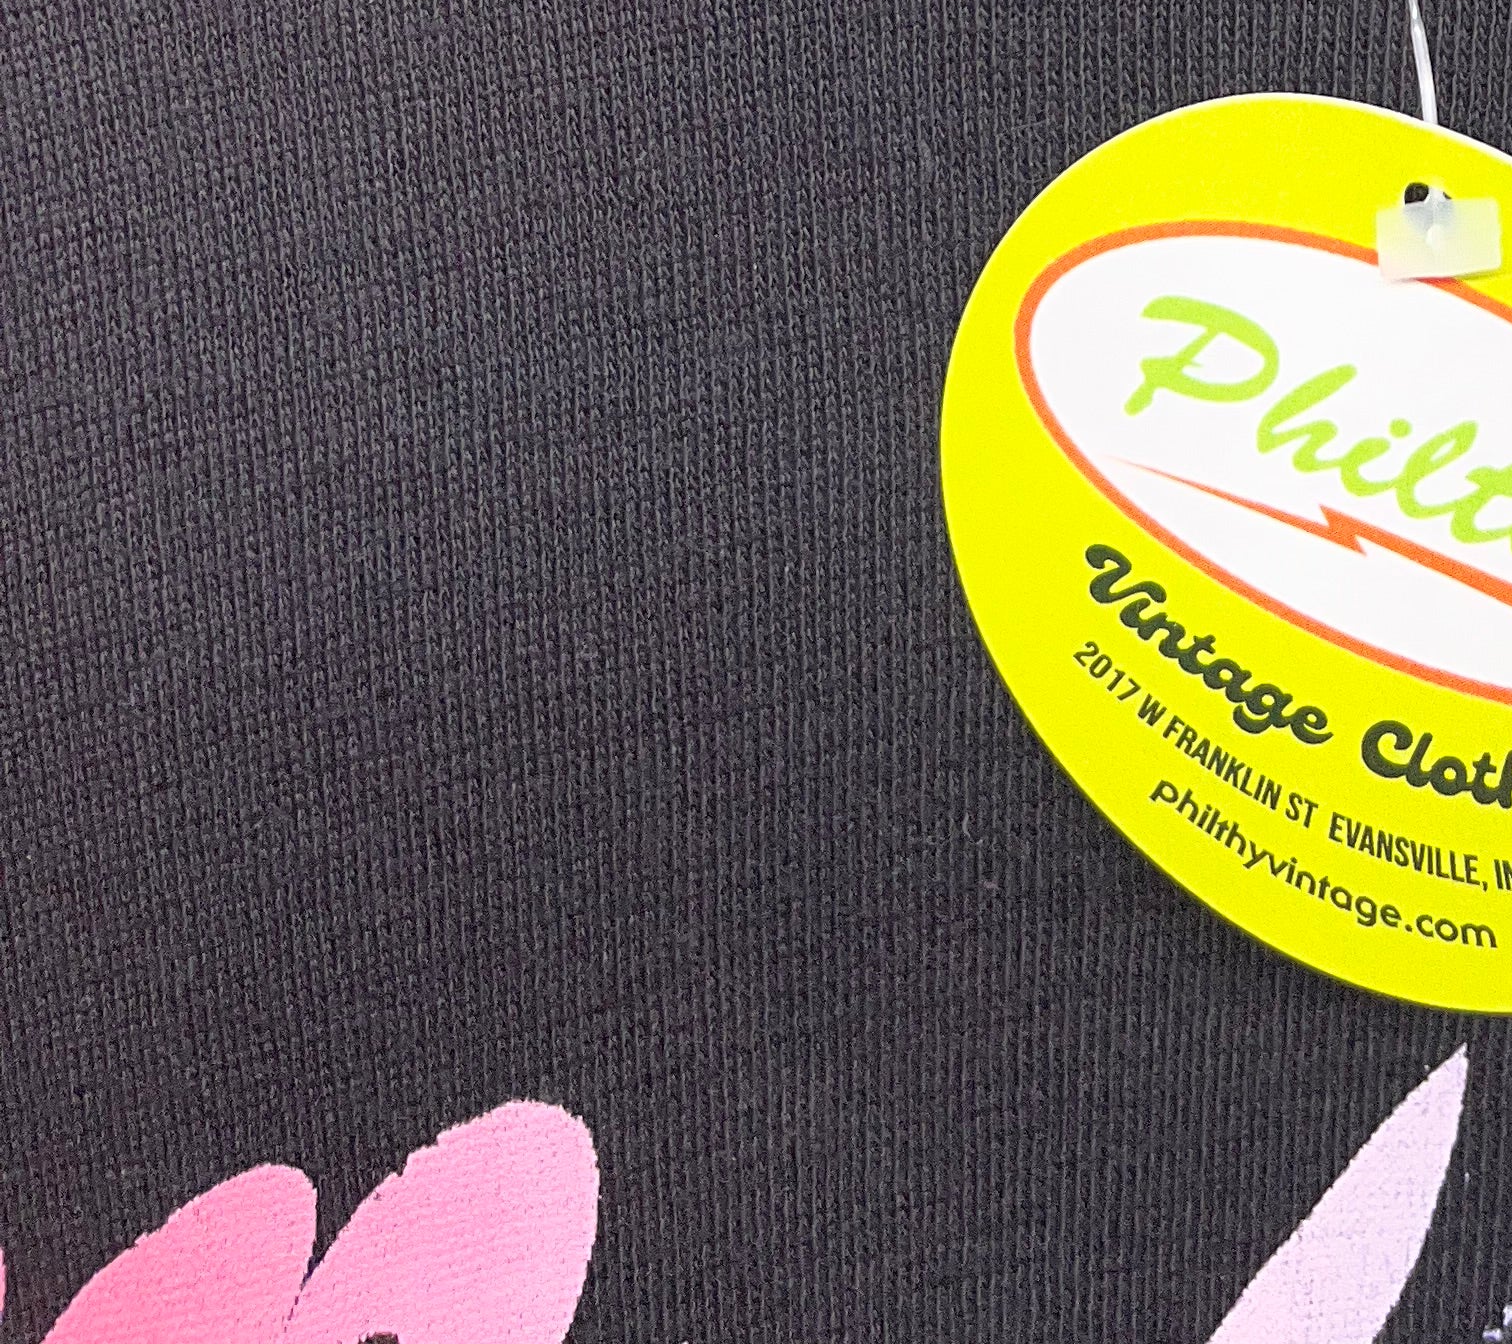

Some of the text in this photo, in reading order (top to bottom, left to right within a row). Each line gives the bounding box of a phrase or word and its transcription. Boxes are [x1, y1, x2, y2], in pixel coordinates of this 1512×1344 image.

[1085, 543, 1334, 745] Vintage
[1072, 640, 1142, 702] 2017
[1137, 693, 1168, 728] W
[1162, 714, 1283, 811] FRANKLIN
[1285, 791, 1319, 830] ST
[1328, 811, 1489, 893] EVANSVILLE,
[1149, 779, 1498, 950] philthyvintage.com
